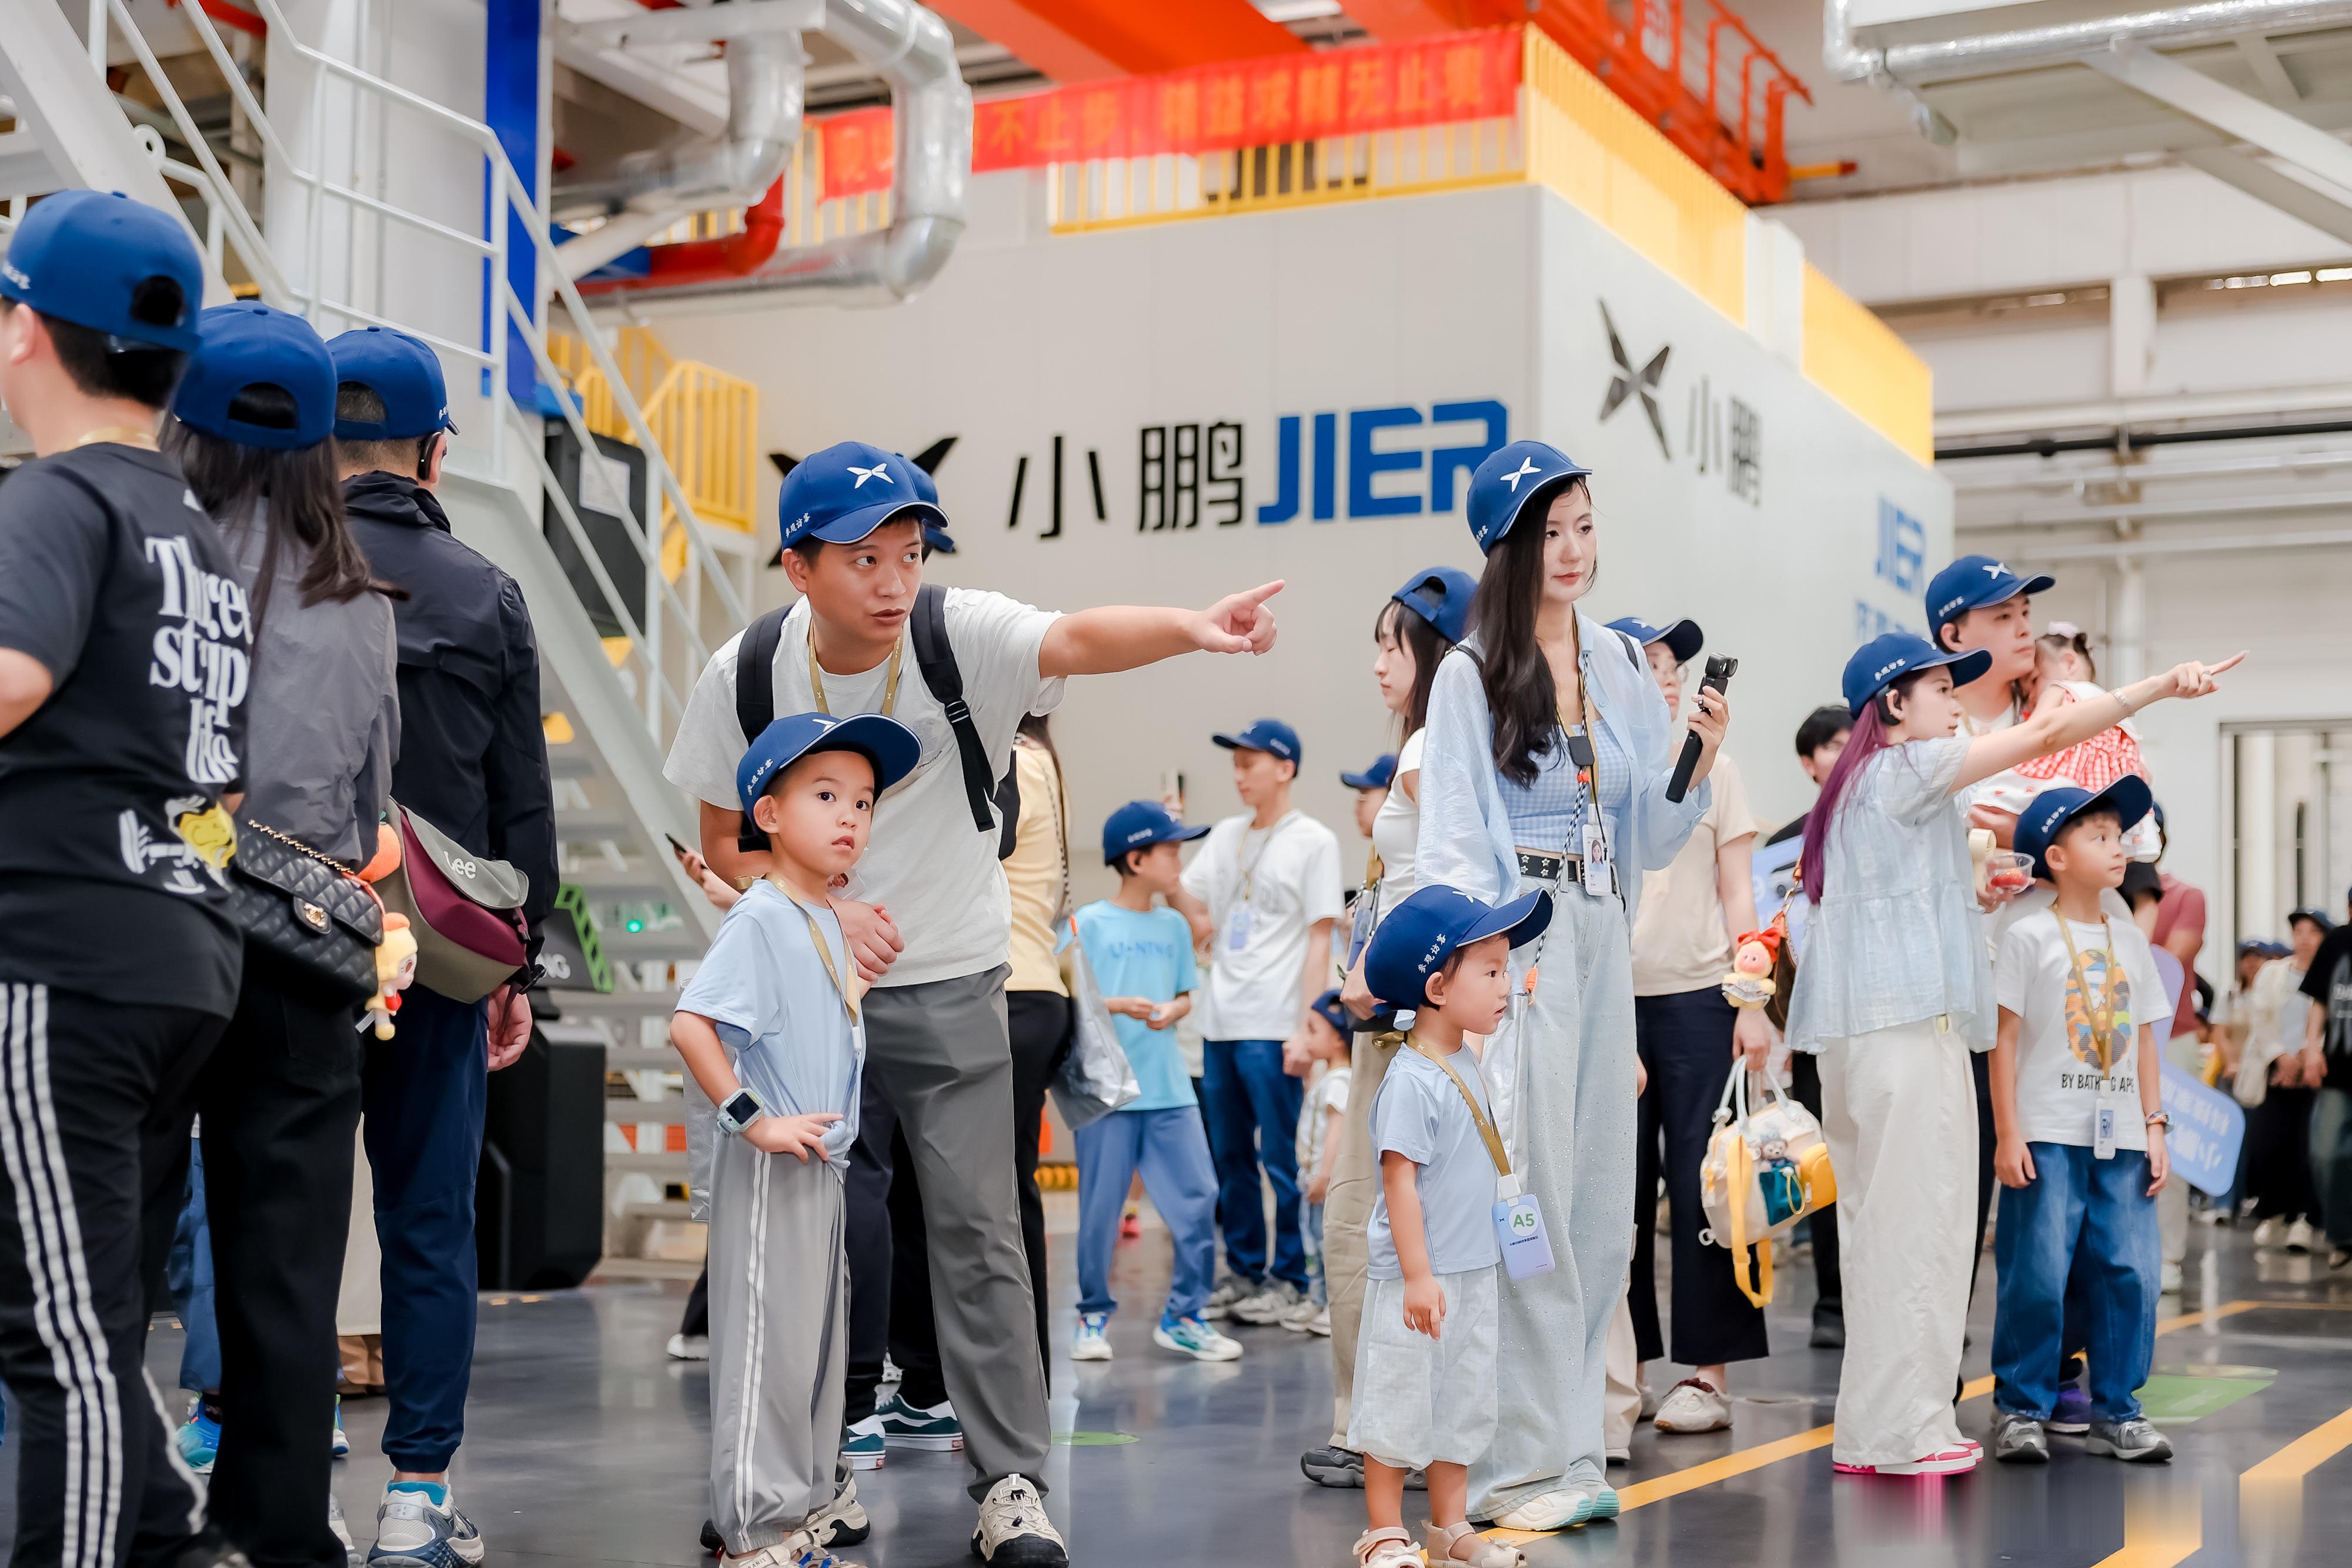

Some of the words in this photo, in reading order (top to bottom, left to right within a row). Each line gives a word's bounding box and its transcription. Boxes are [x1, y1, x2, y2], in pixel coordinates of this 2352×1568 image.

[1007, 420, 1244, 540] 小鹏
[1257, 400, 1509, 526] JIER
[786, 512, 810, 539] 参观访客
[443, 851, 476, 879] Lee
[1418, 933, 1446, 974] 参观访客
[2062, 1074, 2074, 1089] BY
[2077, 1074, 2116, 1092] BATHG
[1513, 1213, 1535, 1228] A5
